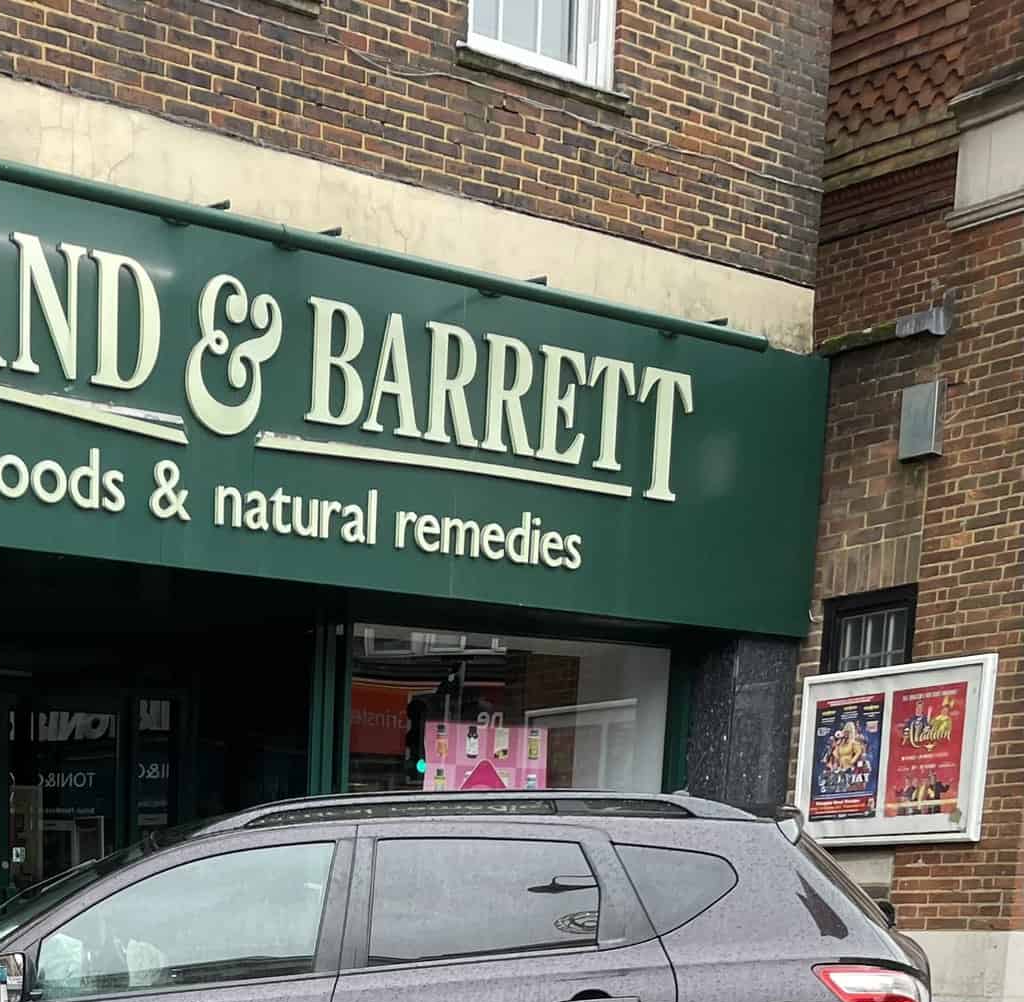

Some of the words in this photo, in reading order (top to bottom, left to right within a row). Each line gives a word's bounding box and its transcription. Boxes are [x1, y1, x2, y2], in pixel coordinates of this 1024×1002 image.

[185, 274, 282, 436] &
[303, 295, 694, 502] BARRETT
[149, 460, 191, 521] &
[214, 484, 378, 545] natural
[395, 511, 582, 569] remedies
